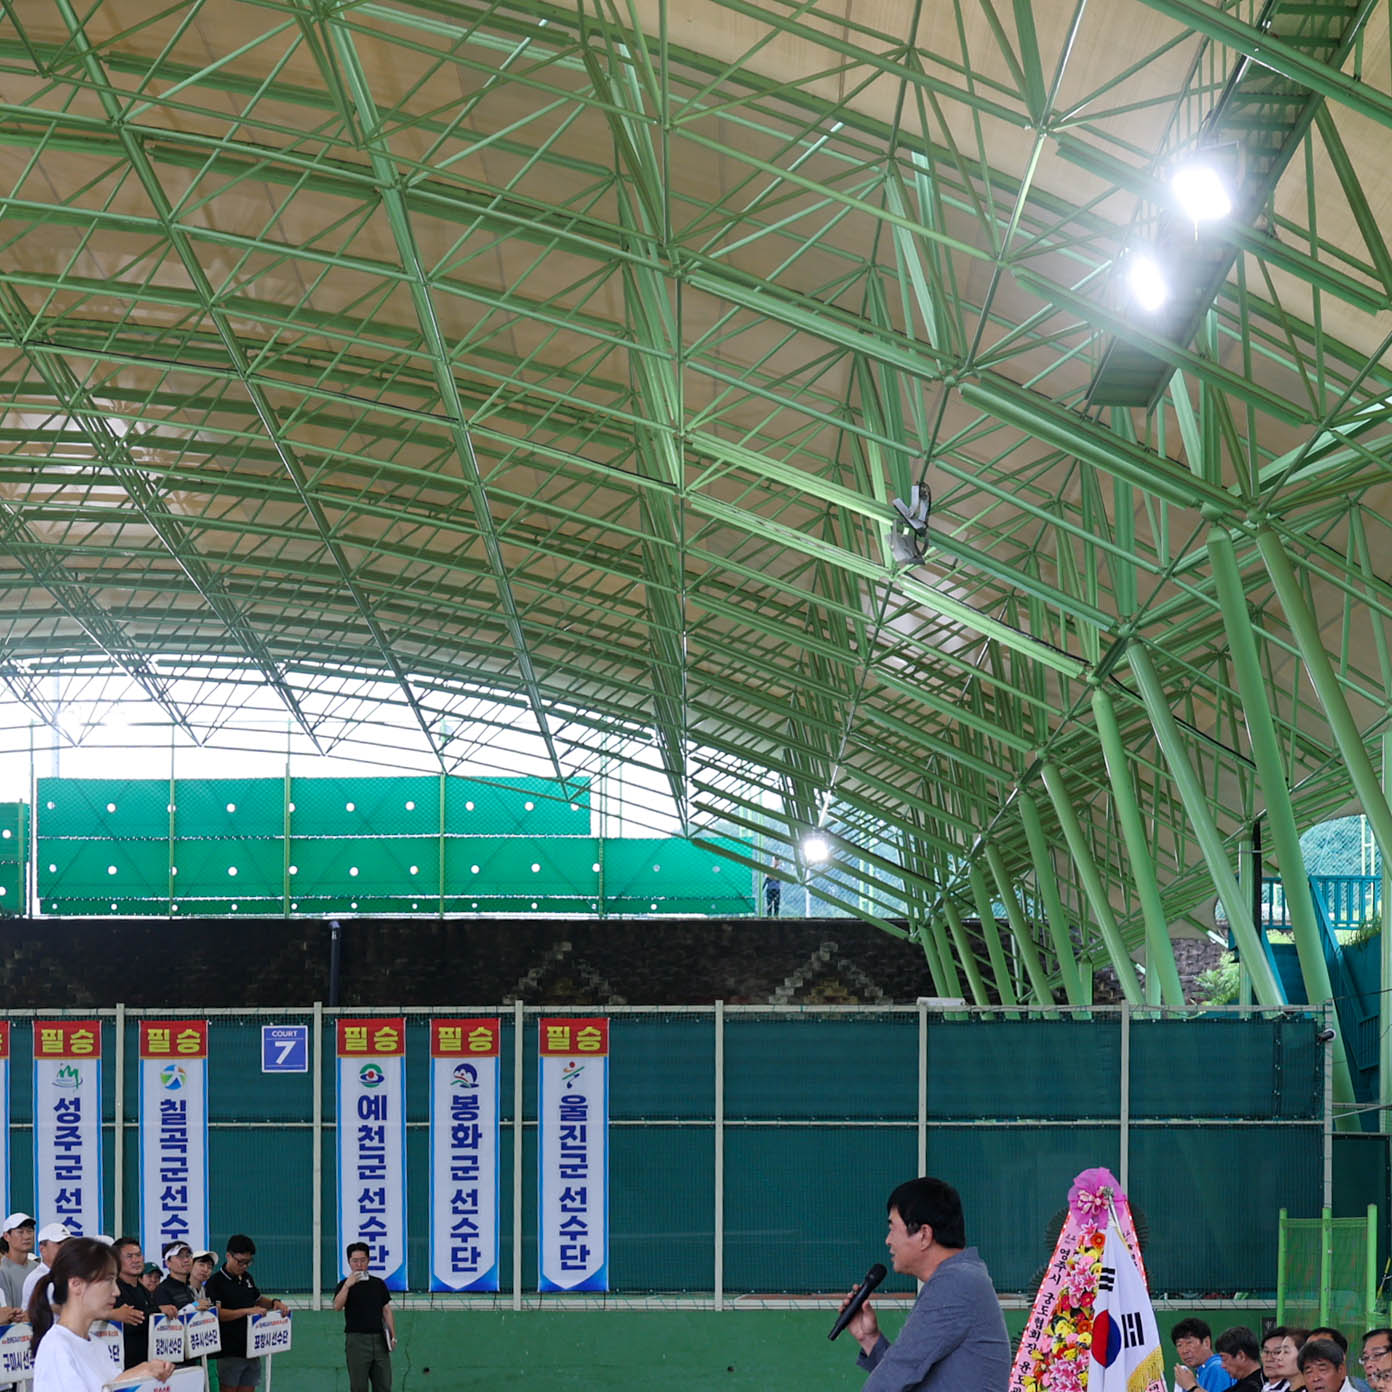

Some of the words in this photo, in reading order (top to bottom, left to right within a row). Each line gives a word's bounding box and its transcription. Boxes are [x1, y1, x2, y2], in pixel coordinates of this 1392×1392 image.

[41, 1029, 94, 1054] 필승
[147, 1029, 201, 1053] 필승
[271, 1030, 298, 1038] COURT
[344, 1027, 399, 1051] 필승
[438, 1027, 493, 1051] 필승
[546, 1026, 602, 1051] 필승
[274, 1041, 297, 1065] 7
[53, 1097, 83, 1181] 성주군
[357, 1095, 388, 1181] 예천군
[450, 1095, 483, 1181] 봉화군
[559, 1094, 589, 1180] 울진군
[450, 1188, 481, 1273] 선수단
[559, 1187, 590, 1272] 선수단
[3, 1352, 22, 1373] 구미시
